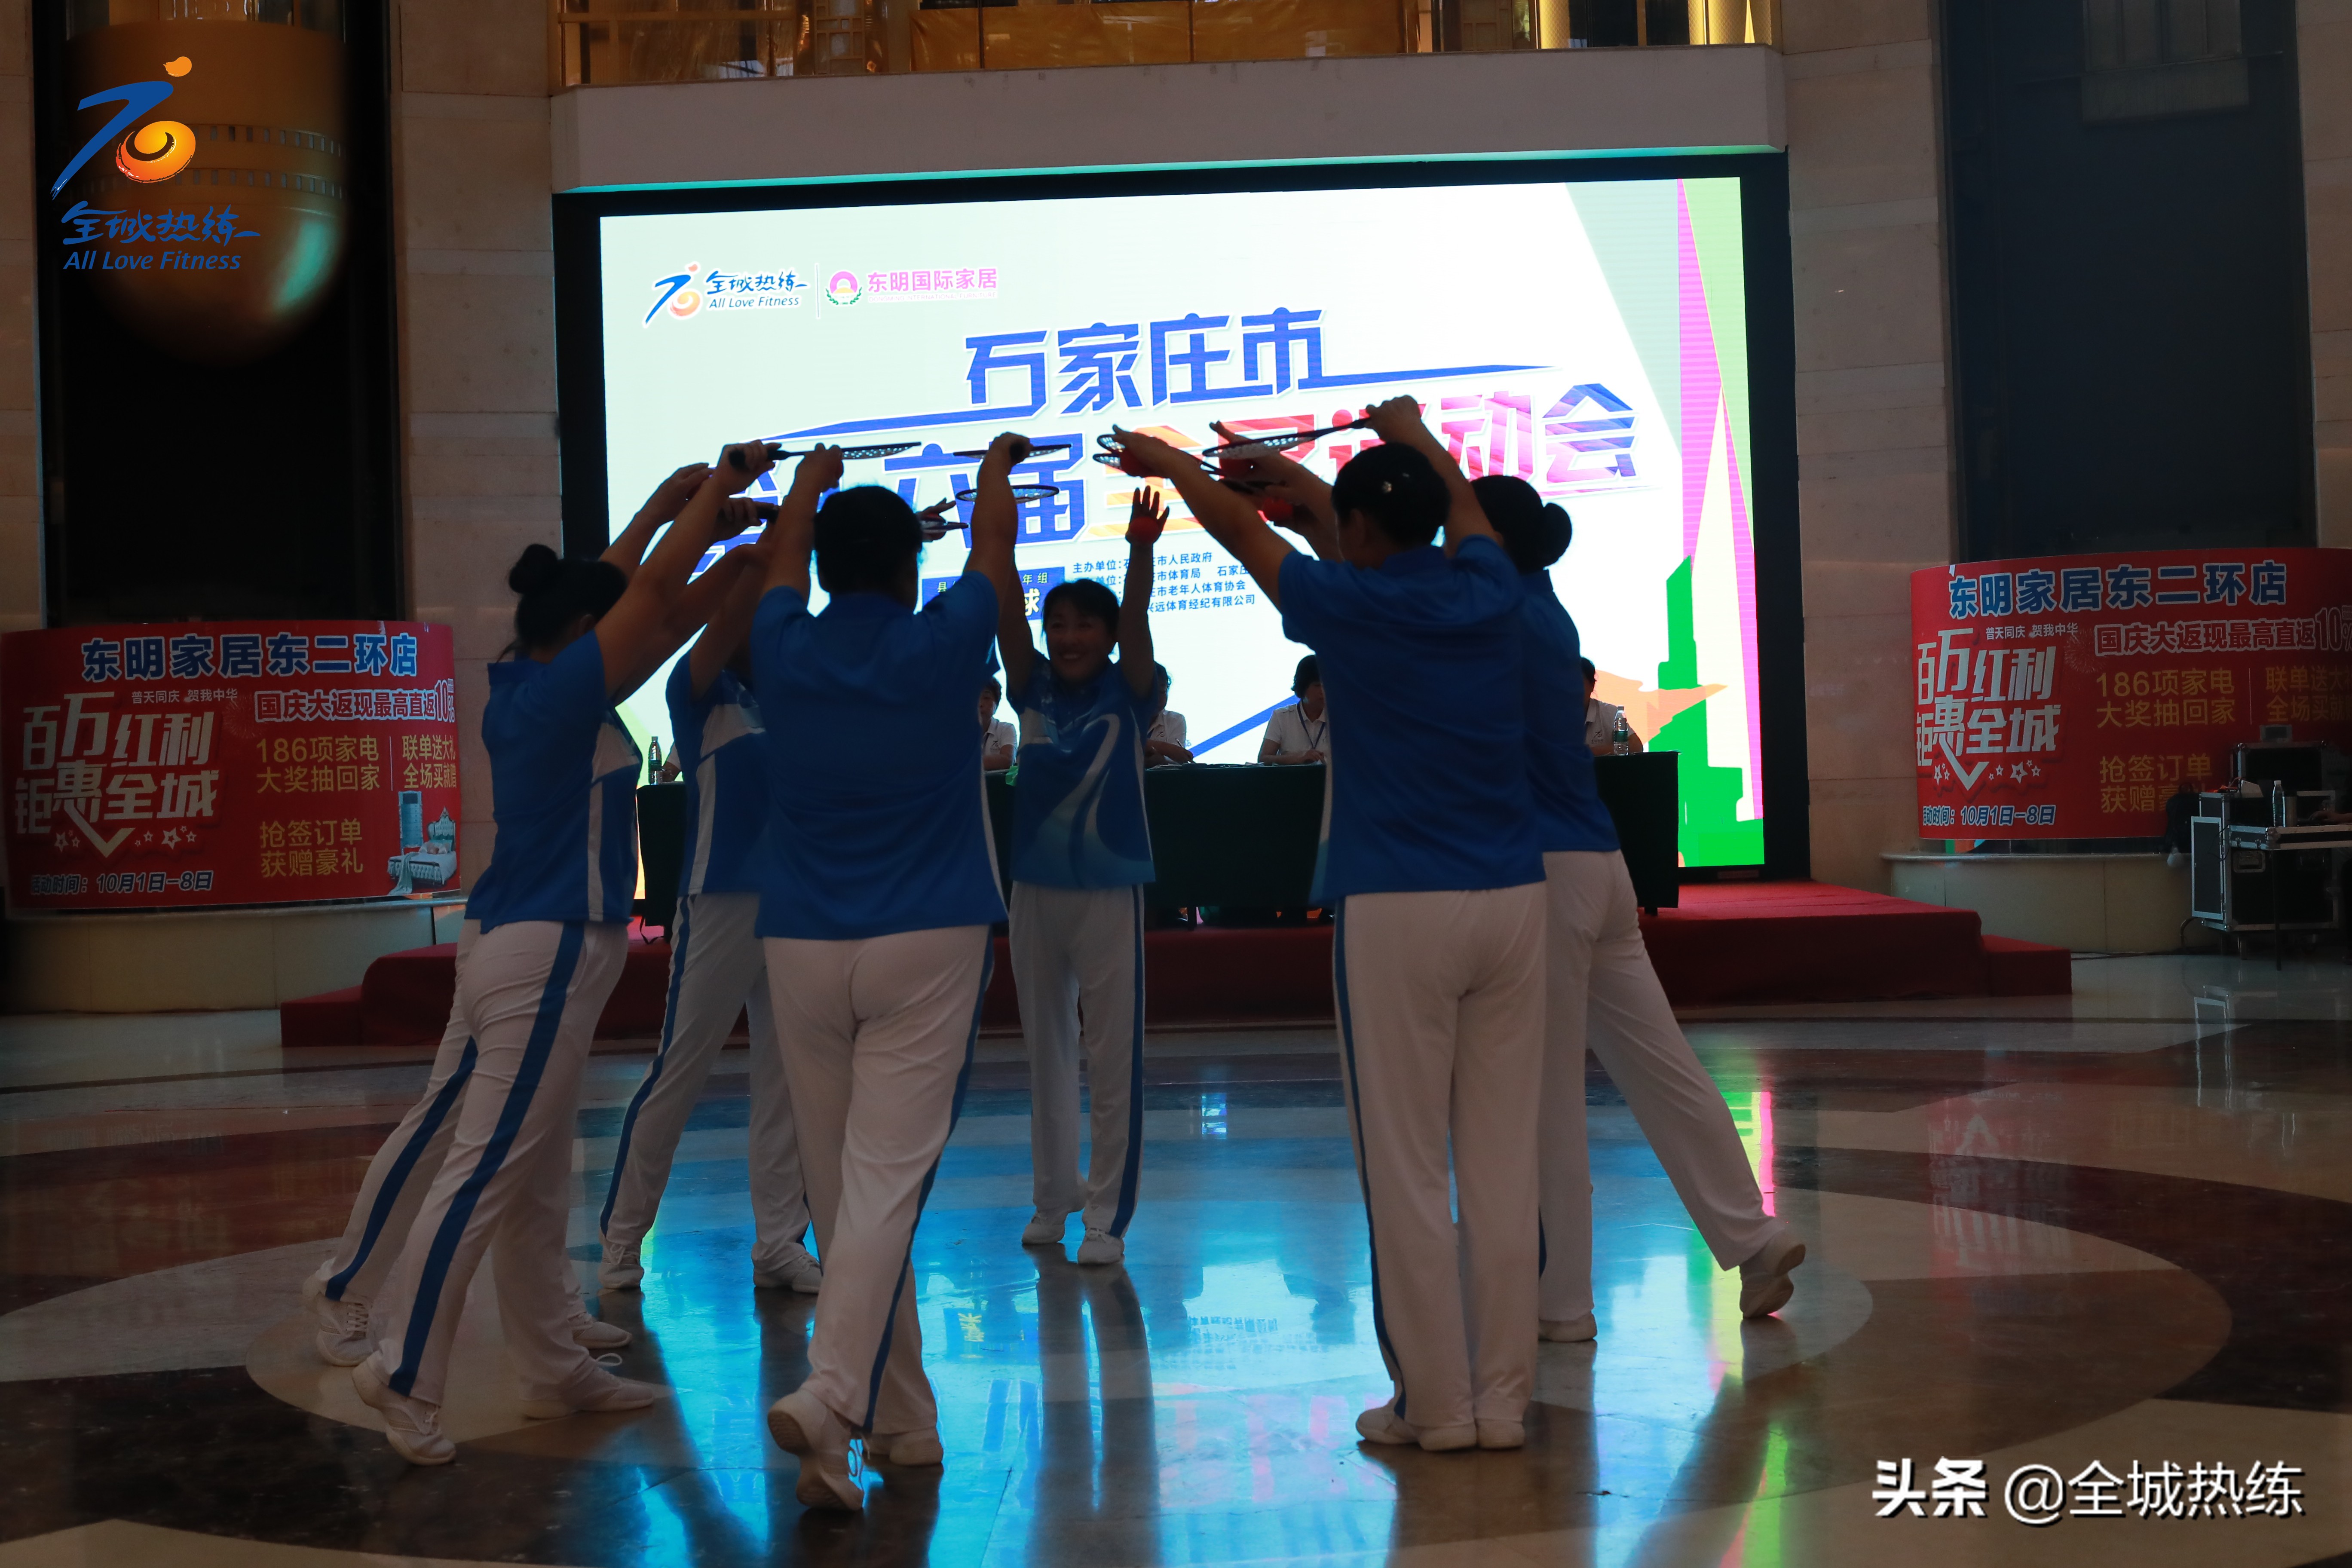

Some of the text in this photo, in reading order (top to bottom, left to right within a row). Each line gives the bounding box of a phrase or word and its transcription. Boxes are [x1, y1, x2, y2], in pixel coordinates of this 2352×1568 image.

[706, 270, 808, 295] 全城热练
[867, 268, 997, 293] 东明国际家居
[709, 296, 799, 309] All Love Fitness
[965, 306, 1324, 417] 石家庄市
[1949, 560, 2287, 619] 东明家居东二环店
[1985, 622, 2078, 639] 普天同庆 贺我中华
[81, 632, 417, 683] 东明家居东二环店
[1917, 628, 2056, 705] 百万红利
[131, 687, 238, 704] 普天同庆 贺我中华
[2096, 668, 2234, 697] 186项家电
[2096, 698, 2236, 728] 大奖抽回家
[22, 691, 214, 771] 百万红利
[256, 734, 456, 763] 186项家电 联单送大礼
[257, 762, 457, 793] 大奖抽回家 全场买就赠
[2099, 753, 2213, 784] 抢签订单
[260, 818, 363, 848] 抢签订单
[260, 848, 364, 878] 获赠豪礼
